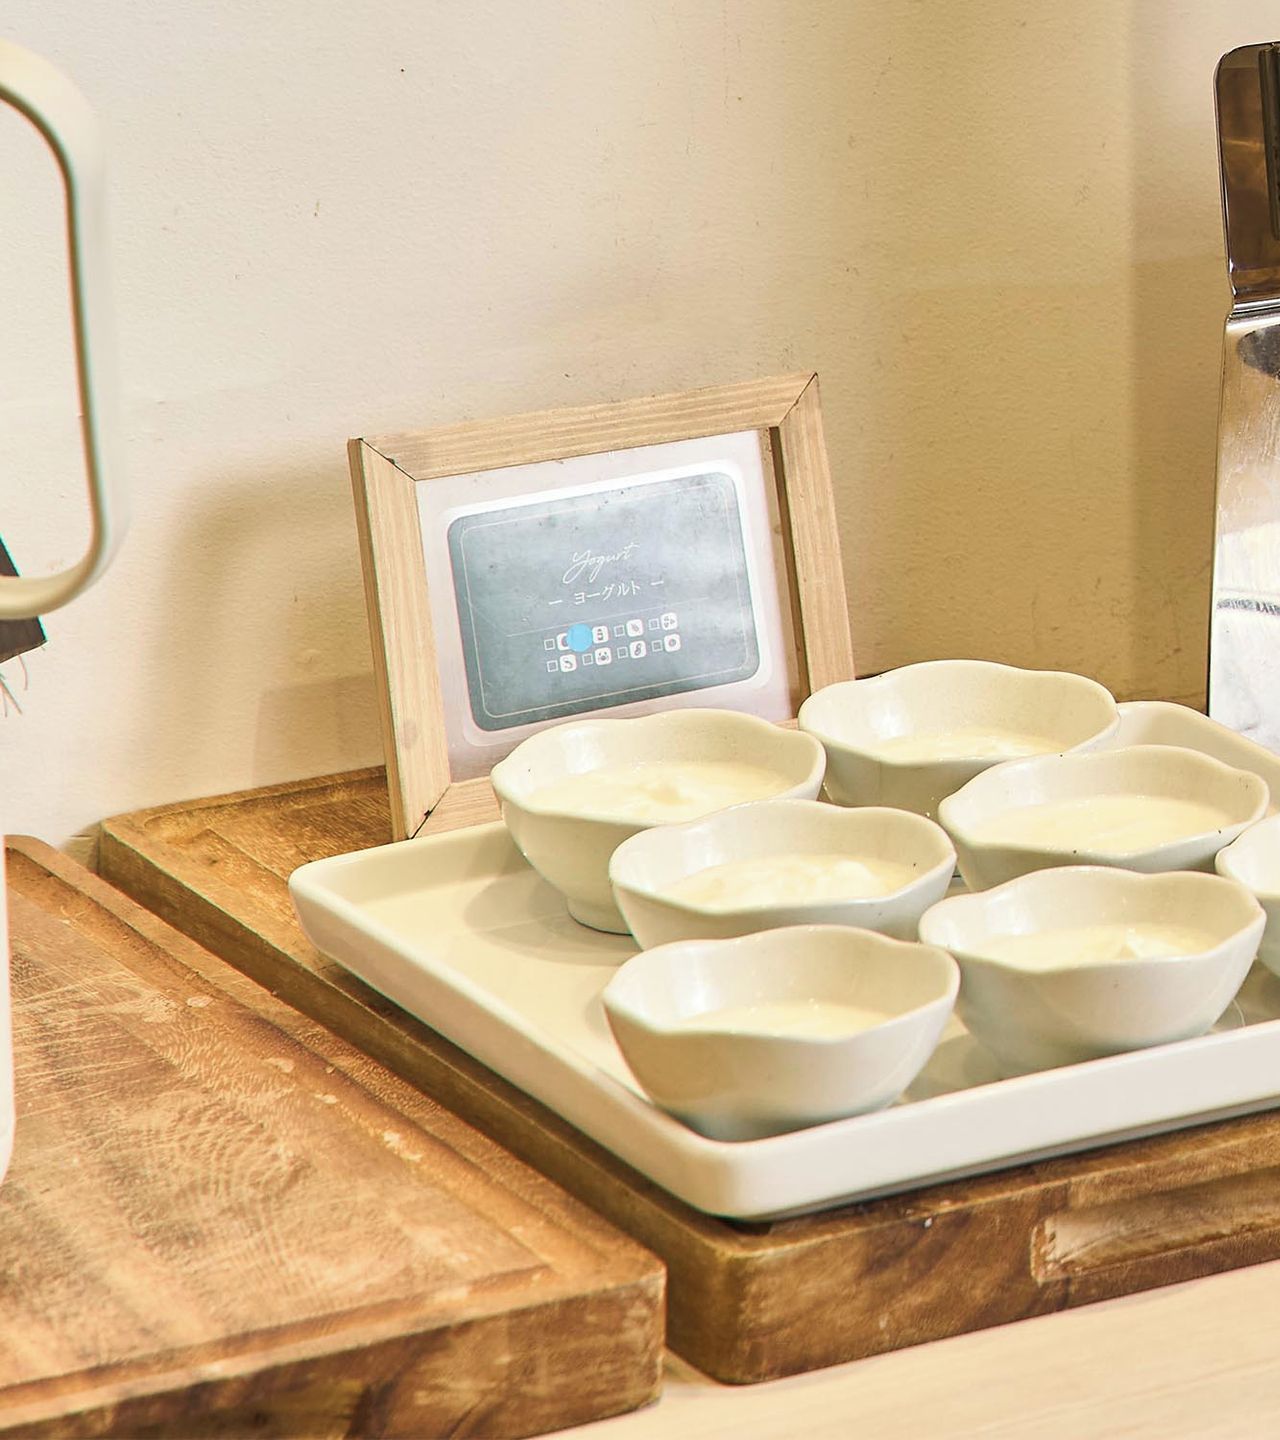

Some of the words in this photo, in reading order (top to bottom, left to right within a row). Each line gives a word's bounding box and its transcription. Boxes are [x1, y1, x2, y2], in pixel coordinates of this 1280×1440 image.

[562, 542, 640, 584] Yogurt
[574, 580, 641, 605] ヨーグルト
